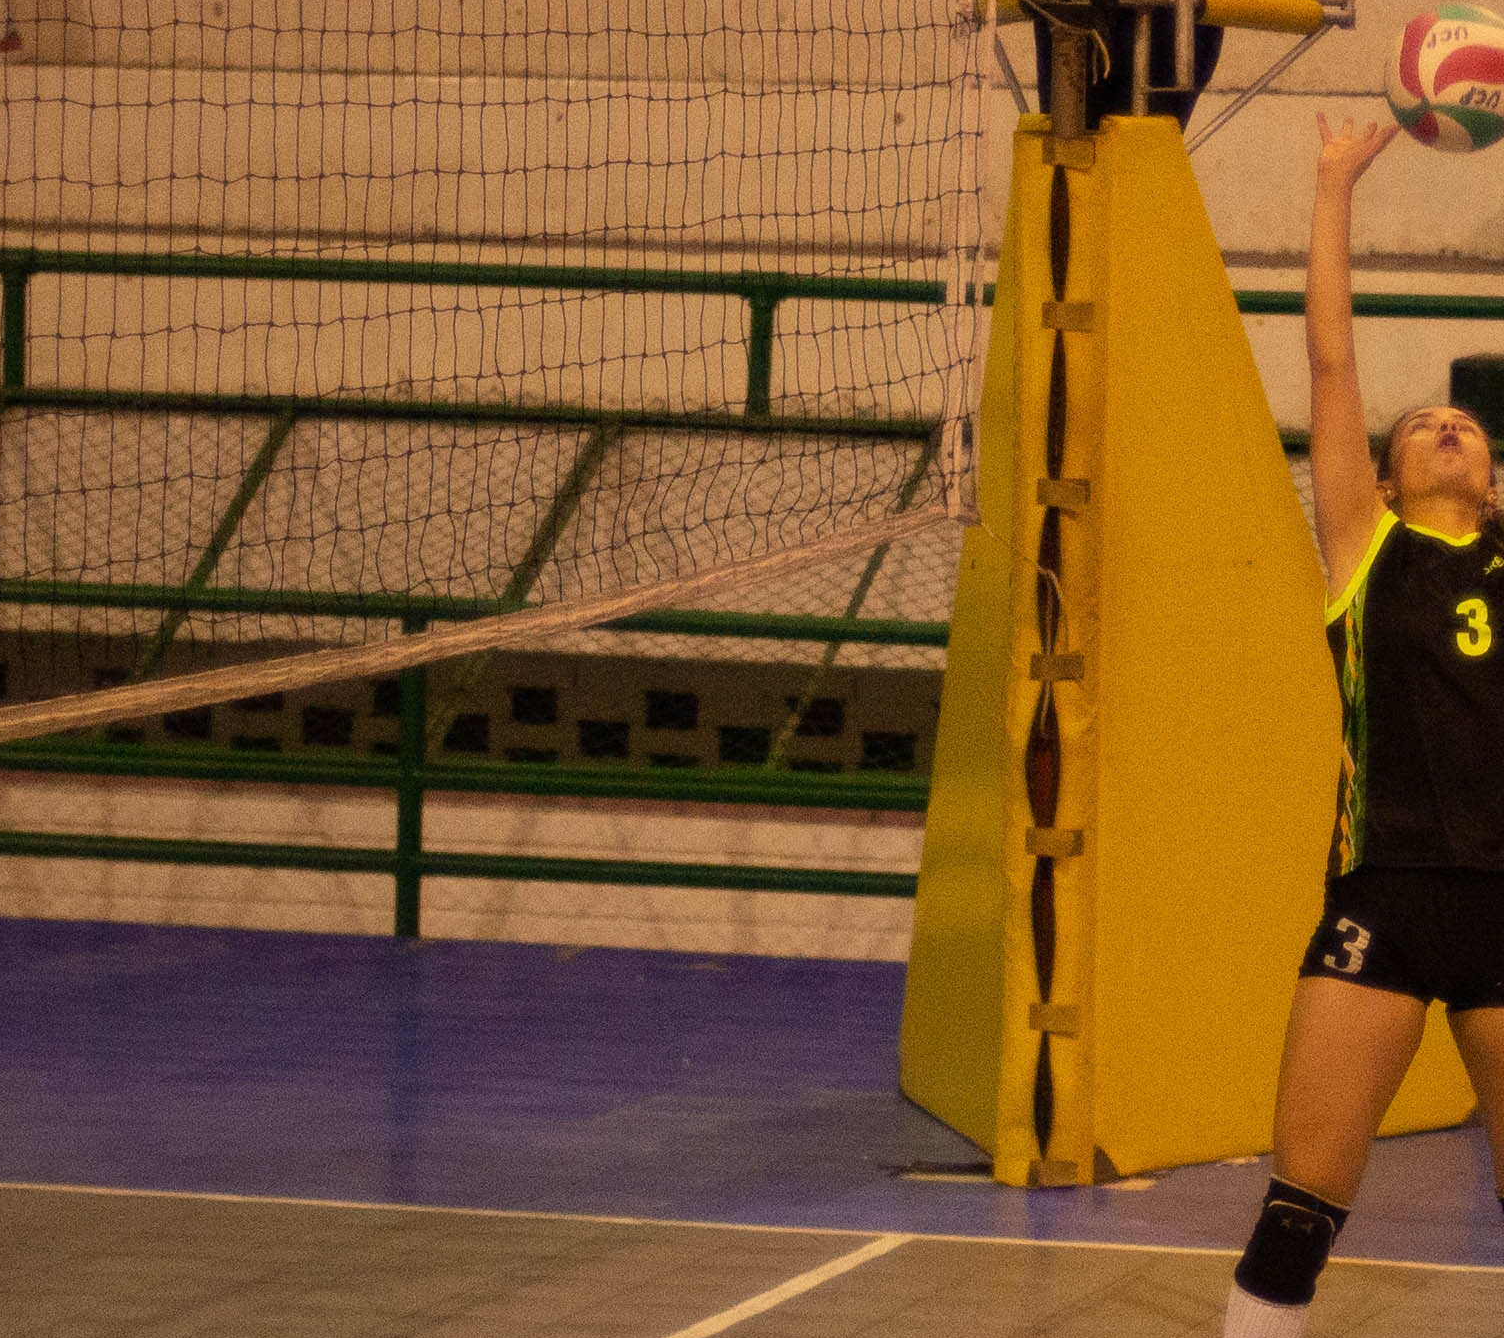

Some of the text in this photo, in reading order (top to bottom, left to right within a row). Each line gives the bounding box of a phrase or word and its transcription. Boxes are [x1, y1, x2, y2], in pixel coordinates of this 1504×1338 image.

[1460, 86, 1501, 109] UCP
[1455, 598, 1493, 657] 3
[1322, 916, 1372, 975] 3
